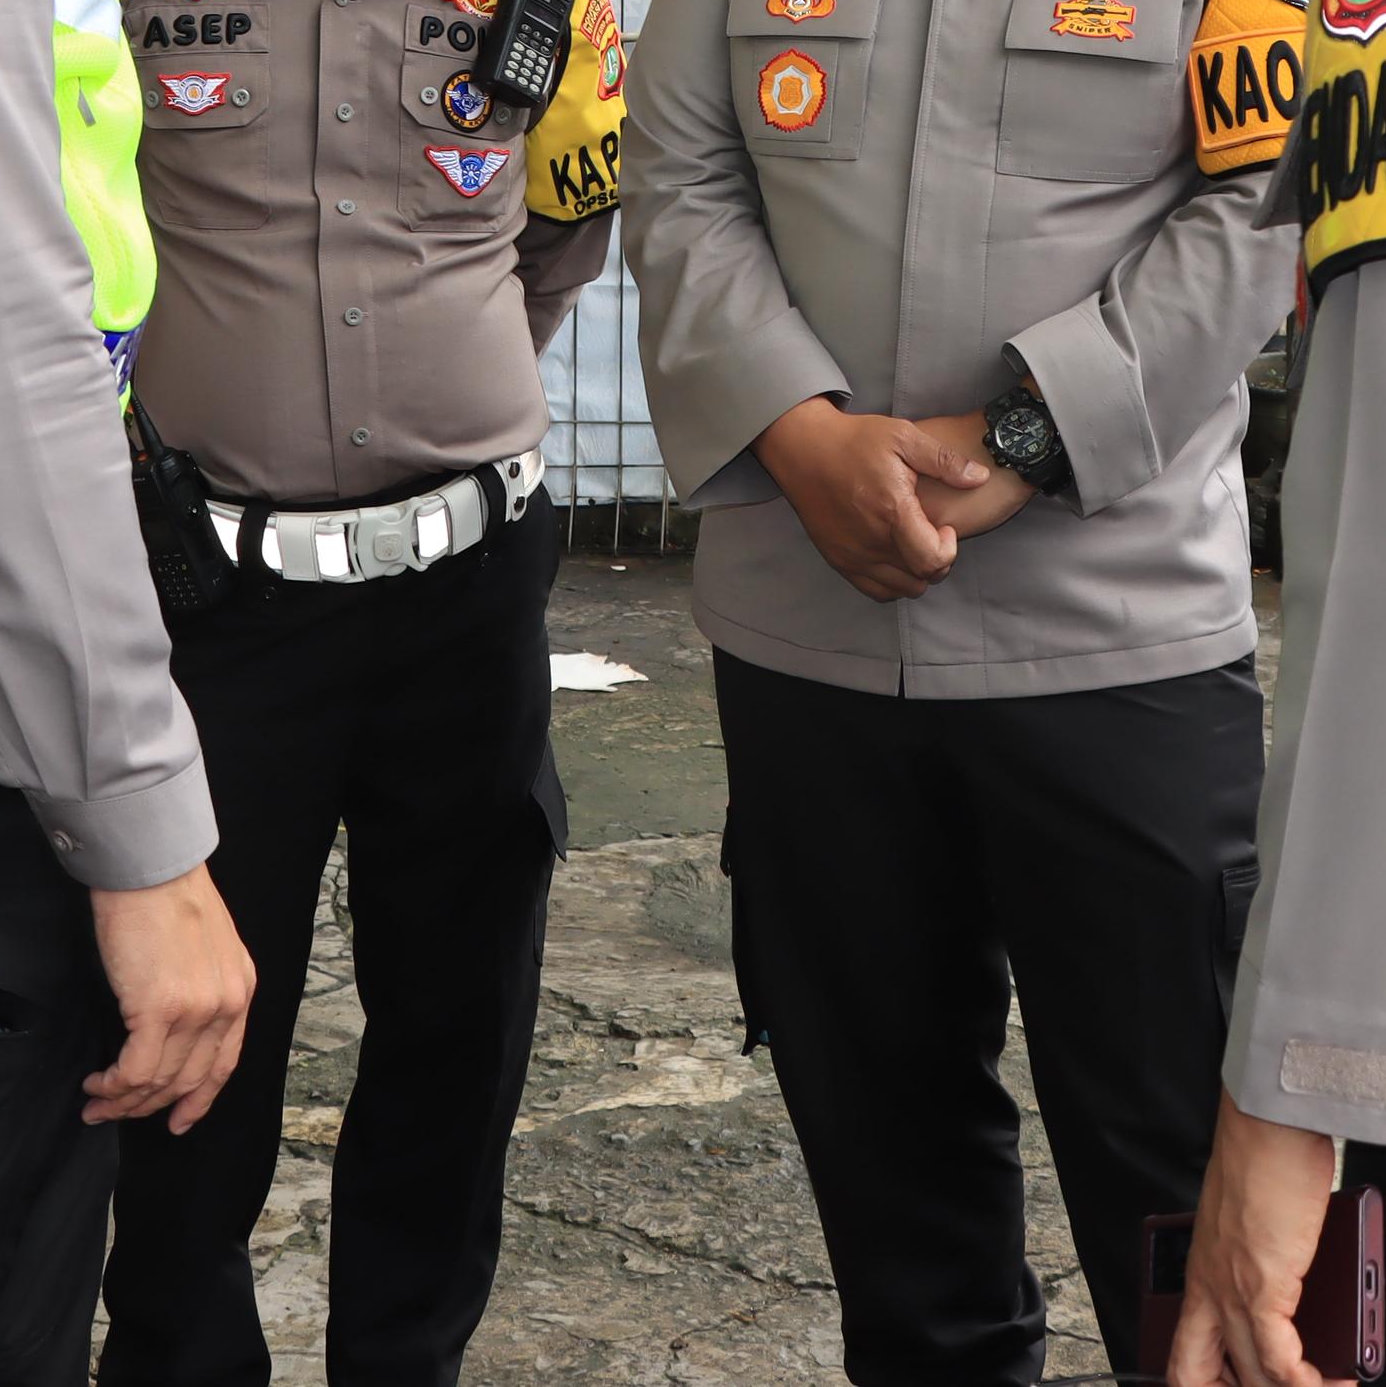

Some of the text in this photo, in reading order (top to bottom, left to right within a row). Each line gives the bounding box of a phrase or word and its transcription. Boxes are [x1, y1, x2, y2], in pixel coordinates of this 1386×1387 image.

[144, 13, 251, 48] ASEP
[1068, 23, 1112, 34] SNIPER
[1197, 40, 1303, 135] KAO
[550, 117, 627, 206] KAP
